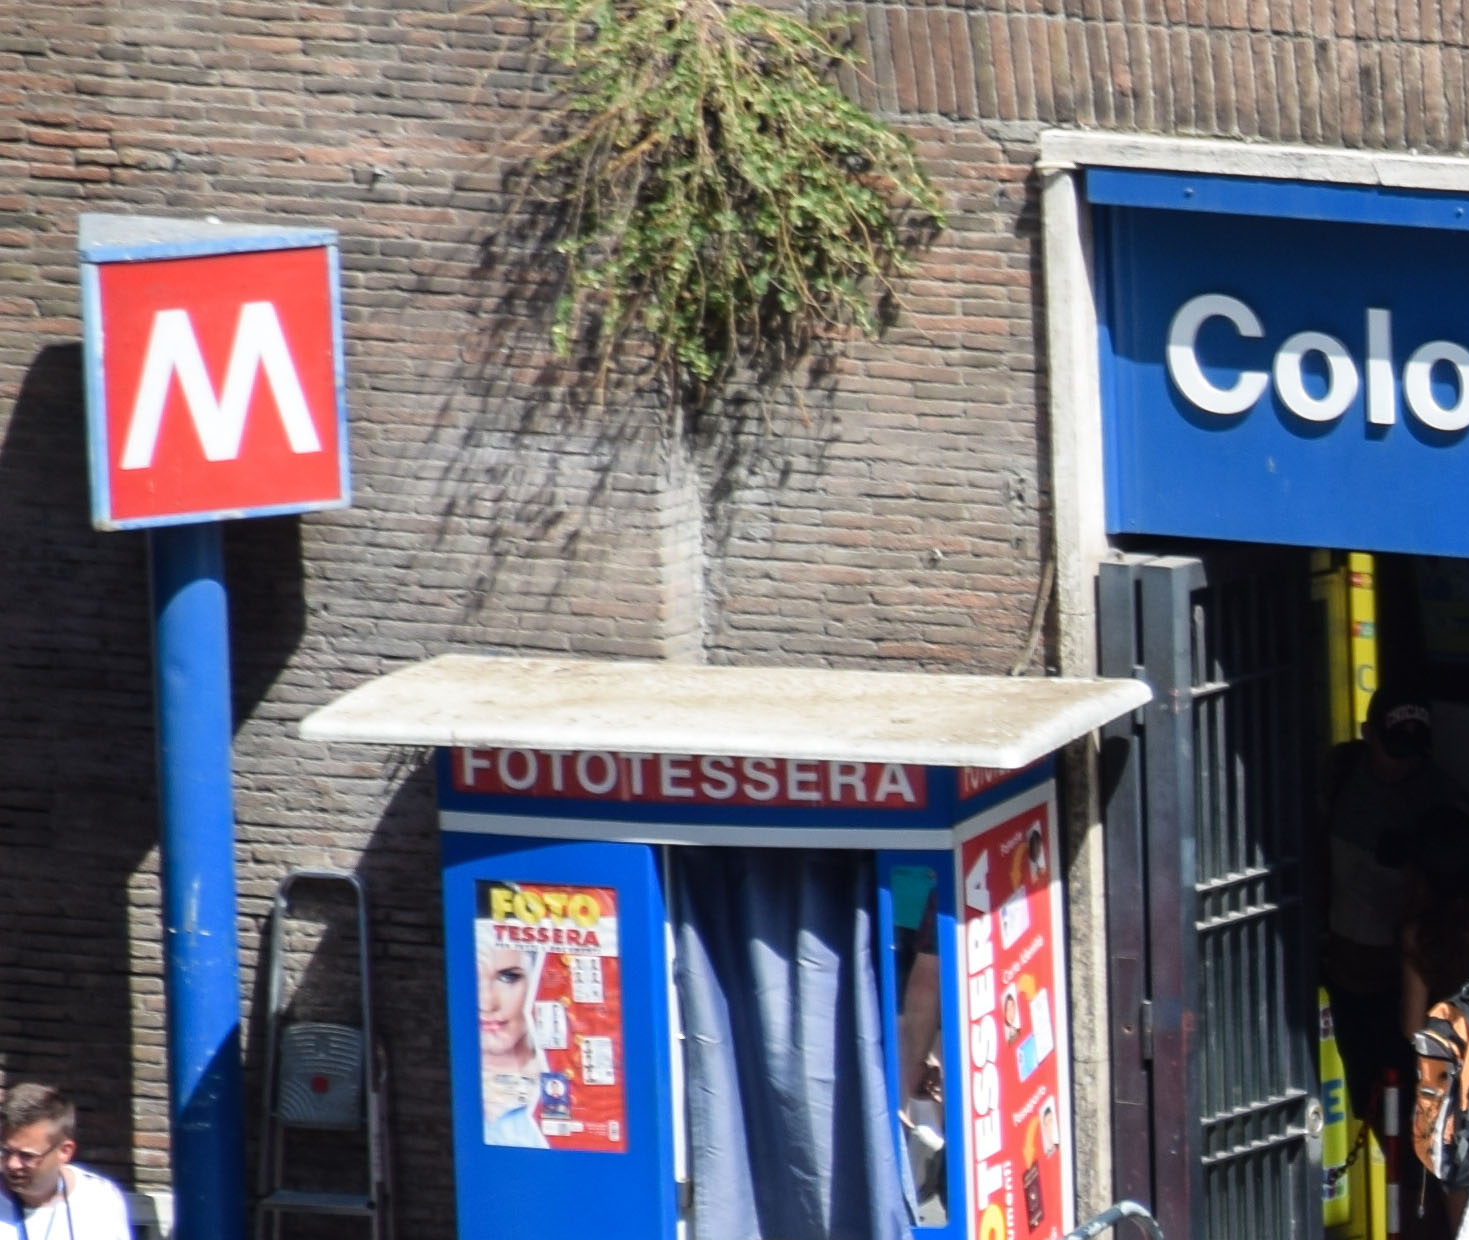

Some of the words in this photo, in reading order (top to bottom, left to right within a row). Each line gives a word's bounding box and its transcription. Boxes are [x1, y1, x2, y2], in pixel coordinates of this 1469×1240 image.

[120, 300, 322, 470] M
[461, 747, 917, 803] FOTOTESSERA
[489, 887, 599, 928] FOTO
[493, 924, 599, 947] TESSERA
